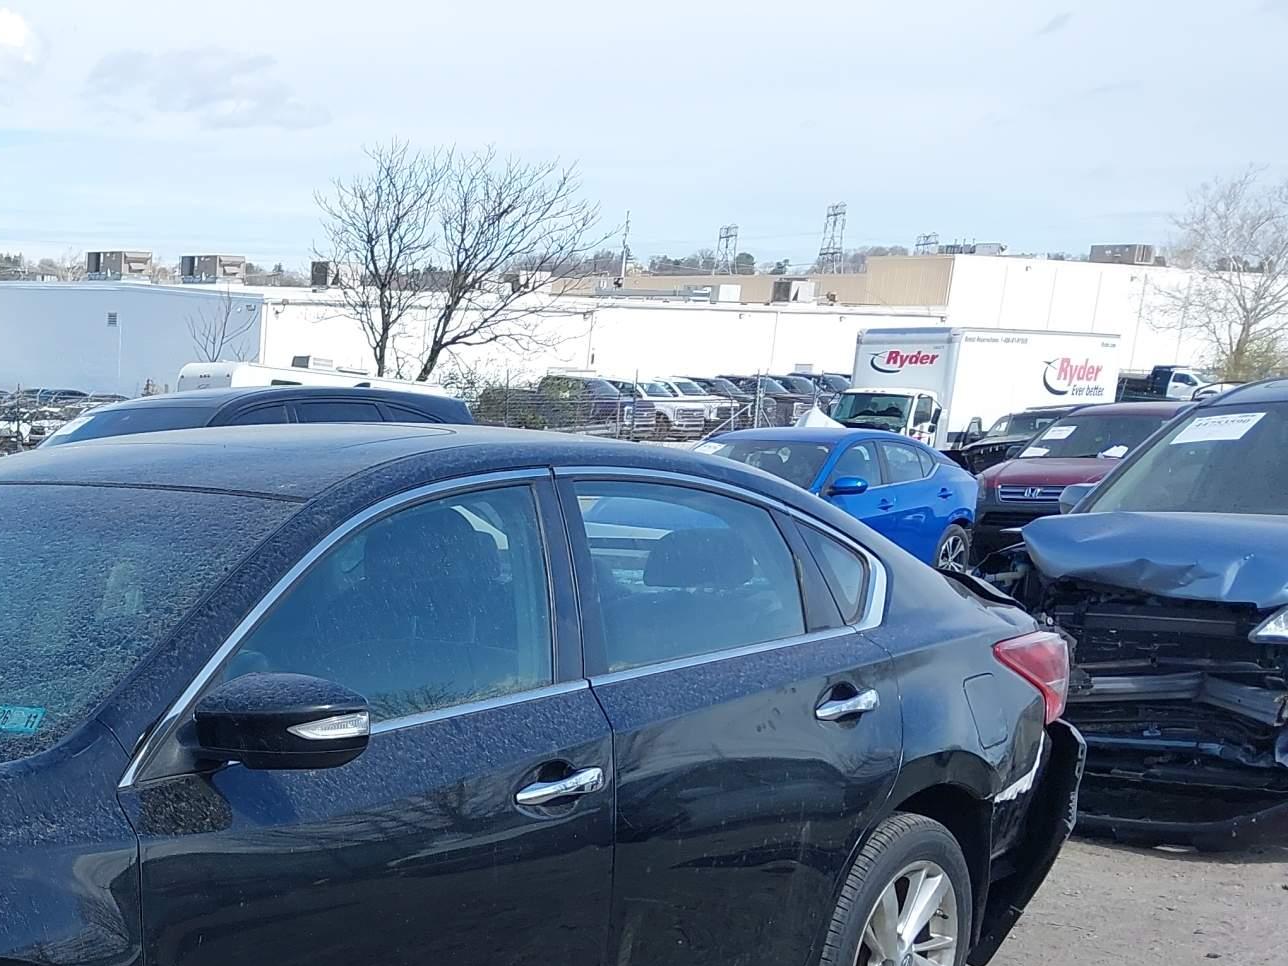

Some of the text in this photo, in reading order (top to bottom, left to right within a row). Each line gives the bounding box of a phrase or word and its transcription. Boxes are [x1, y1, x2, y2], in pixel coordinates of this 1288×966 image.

[886, 351, 939, 369] Ryder
[1056, 357, 1104, 387] Ryder
[1071, 384, 1104, 397] Ever better
